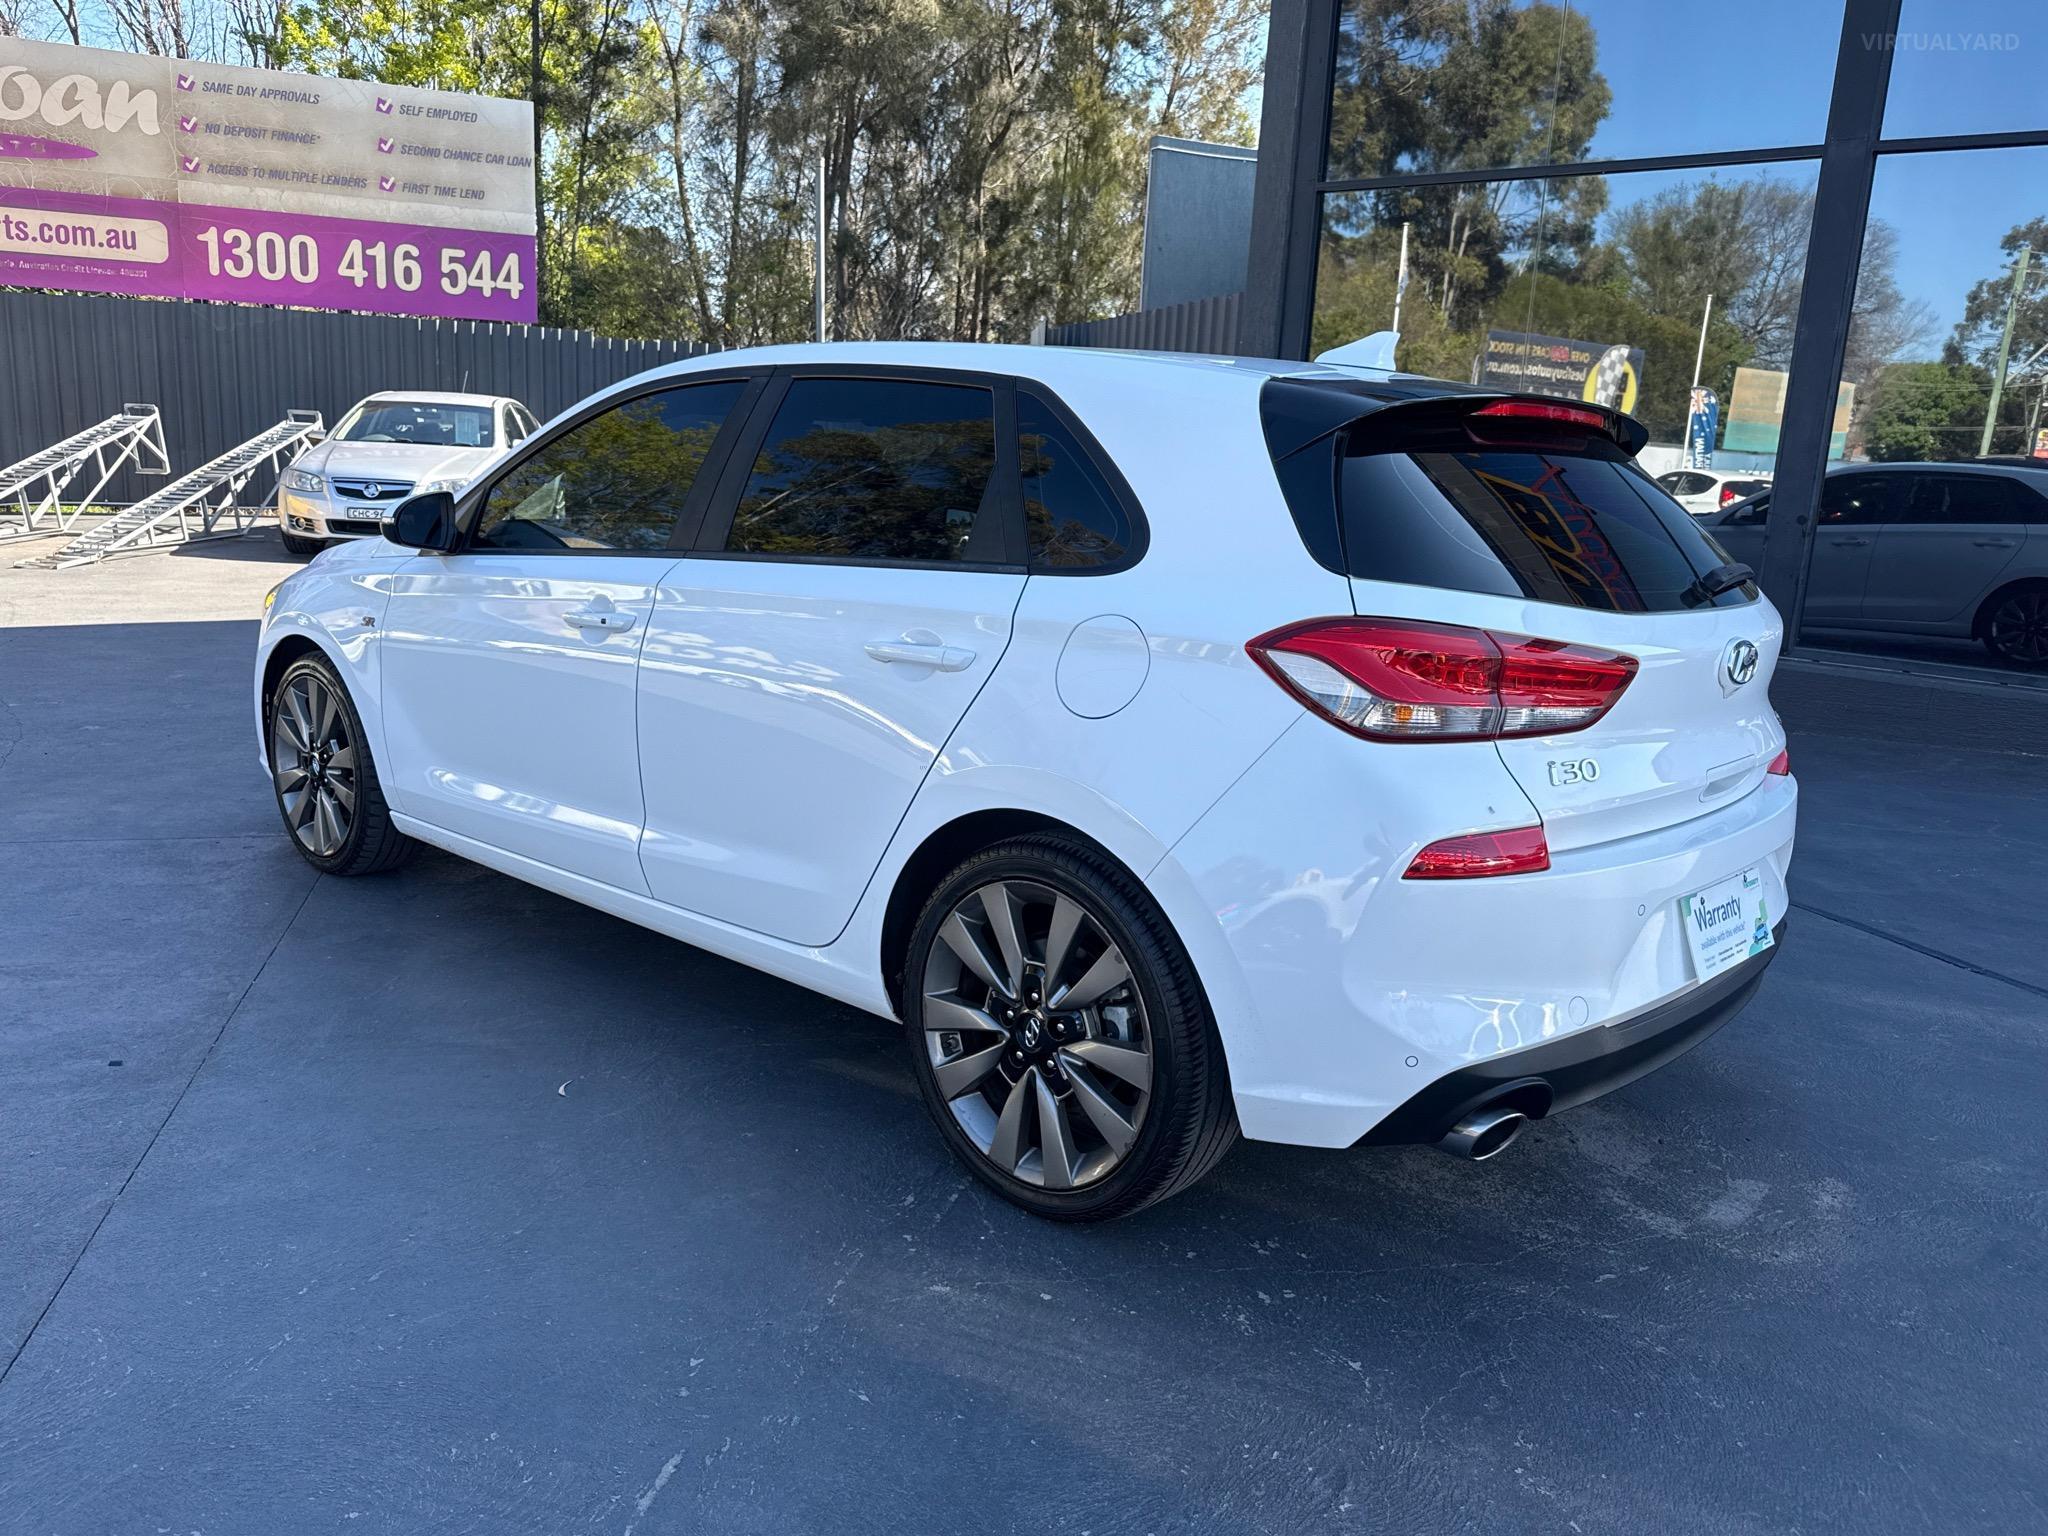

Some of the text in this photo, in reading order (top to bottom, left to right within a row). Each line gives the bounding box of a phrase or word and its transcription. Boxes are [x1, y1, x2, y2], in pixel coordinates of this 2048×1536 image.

[202, 81, 320, 105] SAME DAY APPROVALS
[399, 105, 478, 123] SELF EMPLOYED
[205, 123, 220, 135] NO
[223, 125, 268, 139] DEPOSIT
[400, 144, 532, 168] SECOND CHANCE CAR LOAN
[207, 163, 368, 189] ACCESS TO MULTIPLE LENDERS
[402, 182, 485, 200] FIRST TIME LEND
[0, 214, 137, 250] ts.com.au
[196, 226, 524, 300] 1300 416 544
[1548, 758, 1601, 787] i30
[1694, 895, 1742, 932] Warranty
